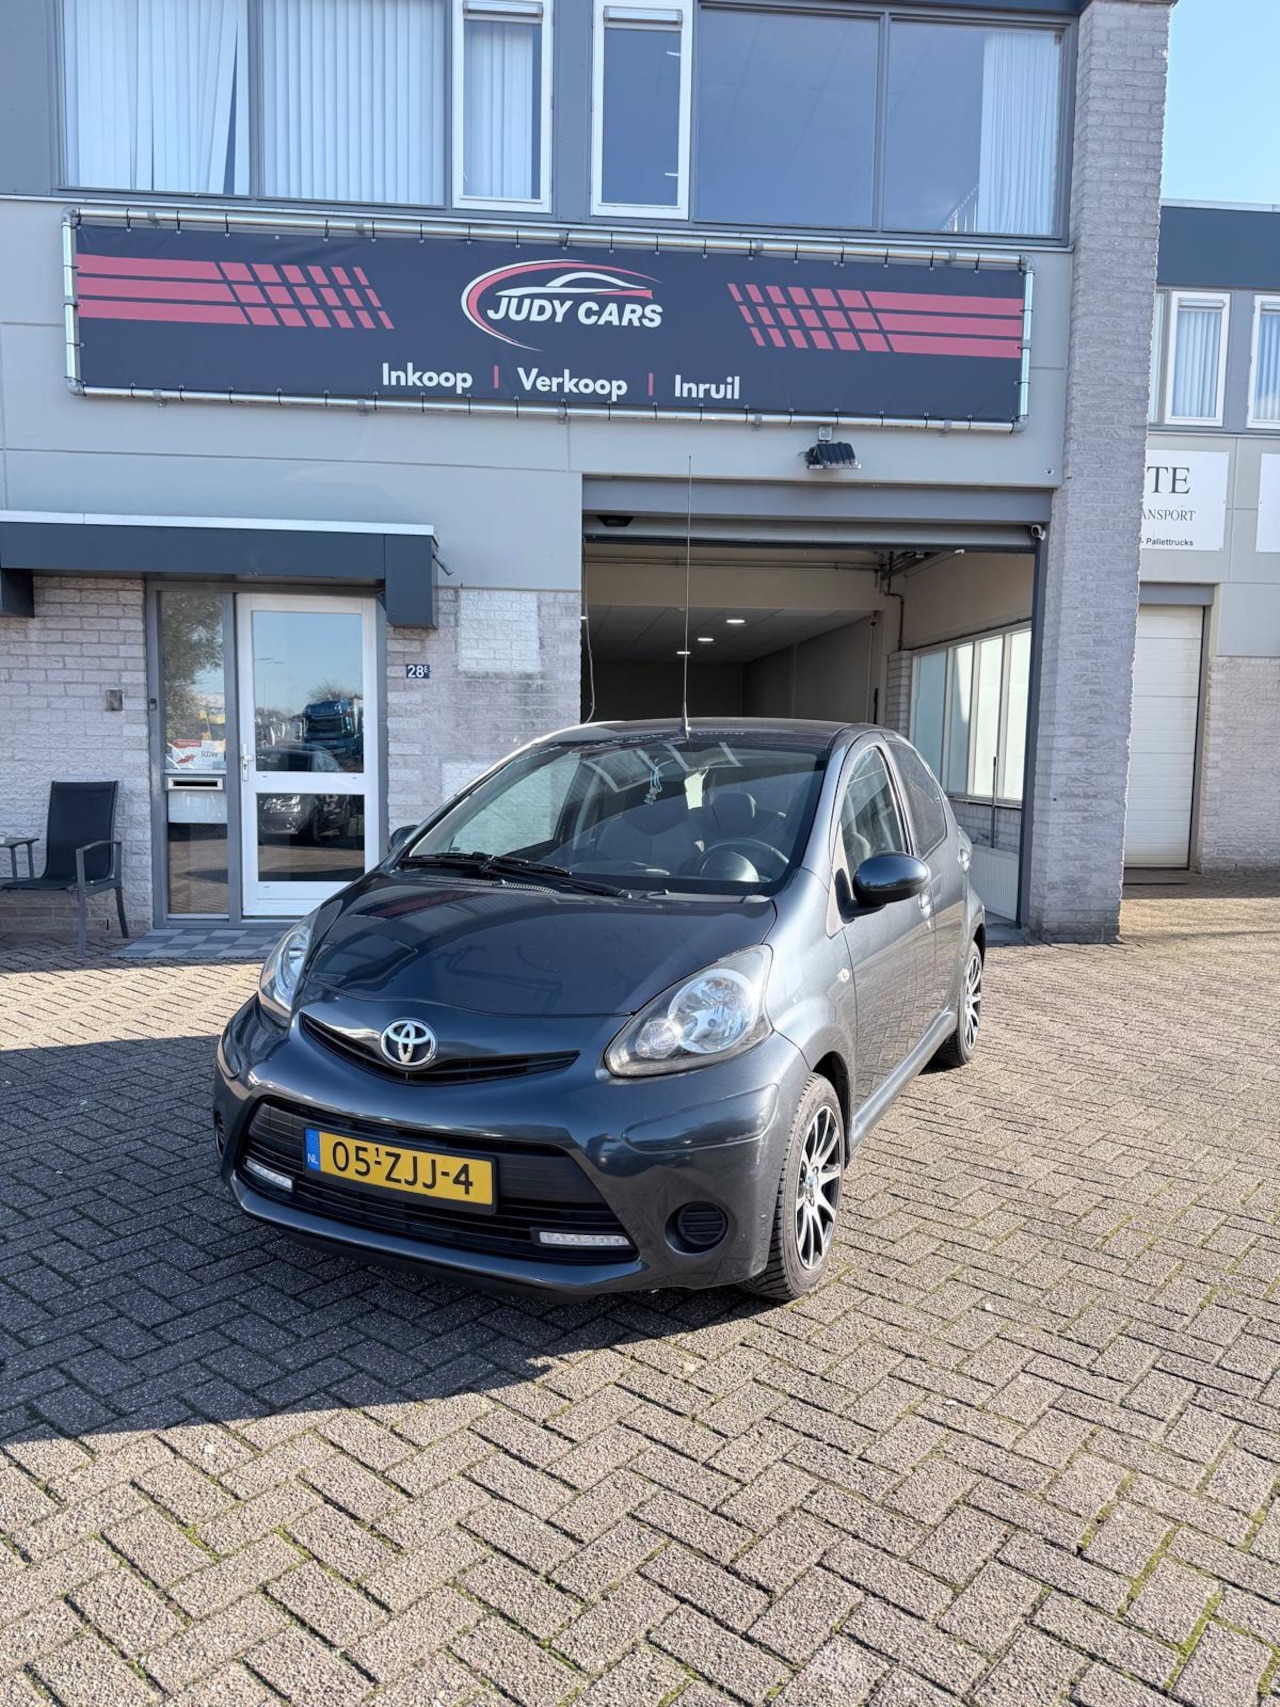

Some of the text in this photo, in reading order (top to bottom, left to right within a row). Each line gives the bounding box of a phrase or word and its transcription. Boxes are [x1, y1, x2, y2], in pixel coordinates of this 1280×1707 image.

[487, 297, 663, 328] JUDY CARS
[382, 362, 740, 401] Inkoop Verkoop Inruil
[1146, 466, 1190, 494] TE
[1146, 538, 1194, 547] Pallettrucks
[307, 1152, 319, 1165] NL
